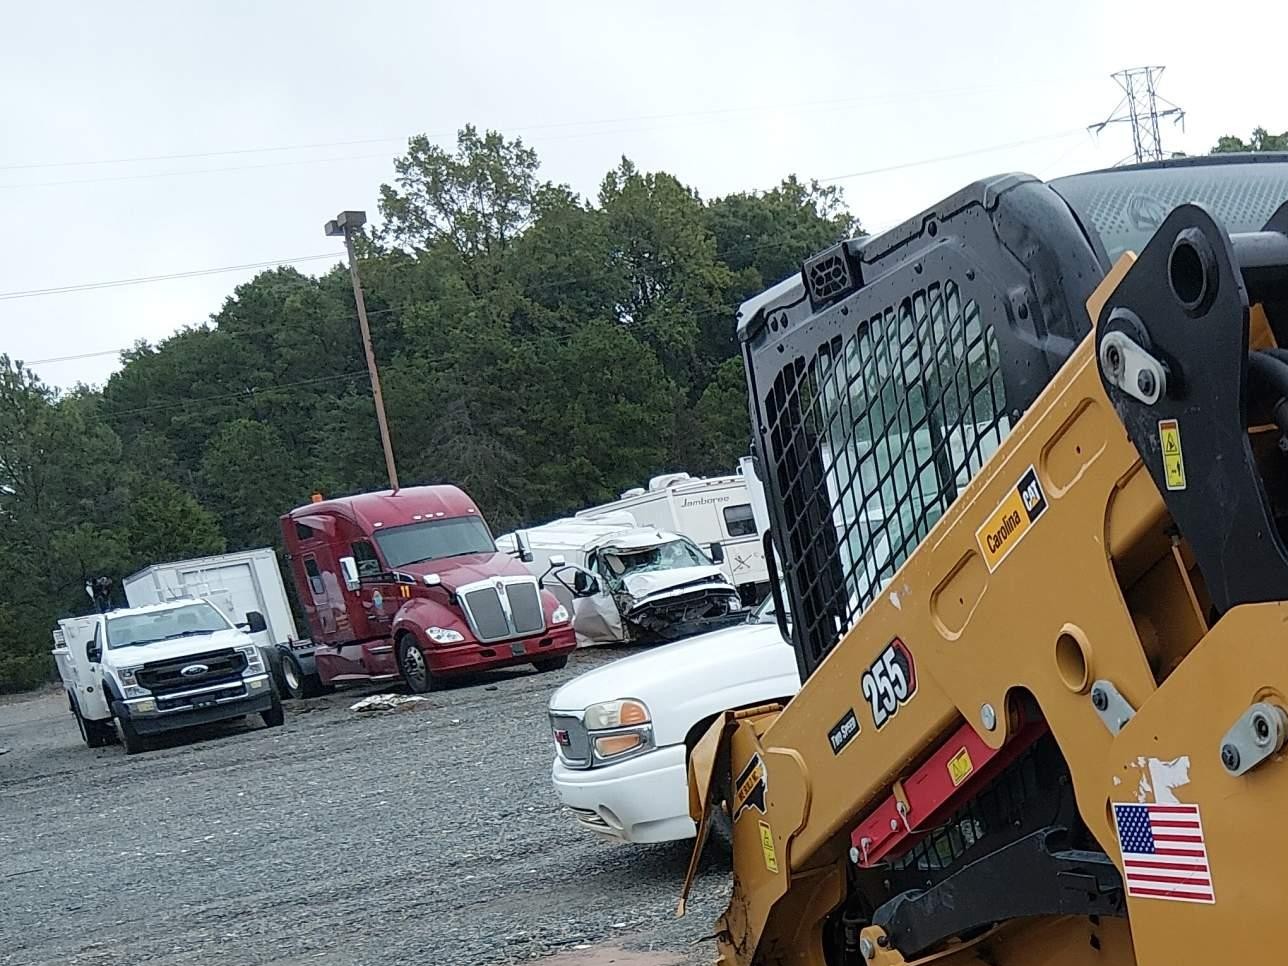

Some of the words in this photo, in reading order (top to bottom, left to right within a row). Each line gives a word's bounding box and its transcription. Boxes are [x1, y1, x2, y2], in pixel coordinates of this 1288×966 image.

[681, 496, 729, 508] Jamboree
[1022, 480, 1041, 512] CAT
[986, 510, 1021, 554] Carolina
[862, 646, 908, 727] 255
